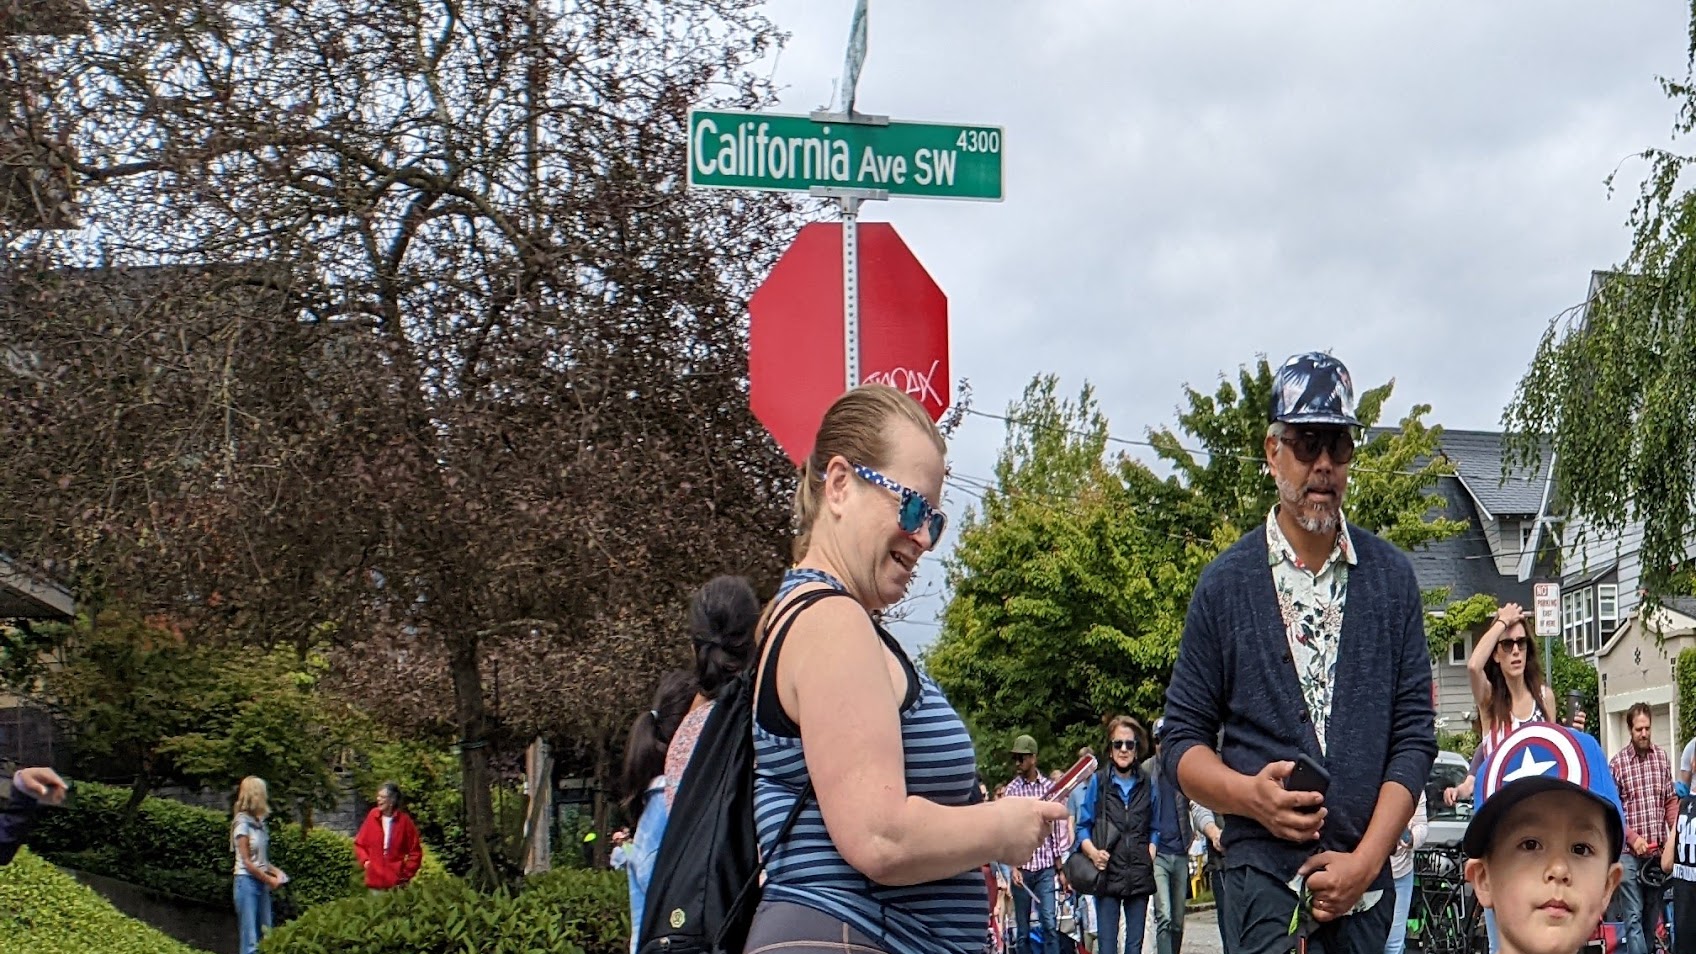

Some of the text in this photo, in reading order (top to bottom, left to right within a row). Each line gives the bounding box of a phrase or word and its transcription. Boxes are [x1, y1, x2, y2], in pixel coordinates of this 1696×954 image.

[694, 118, 957, 186] California Ave SW
[957, 130, 999, 153] 4300
[1536, 585, 1548, 596] NO
